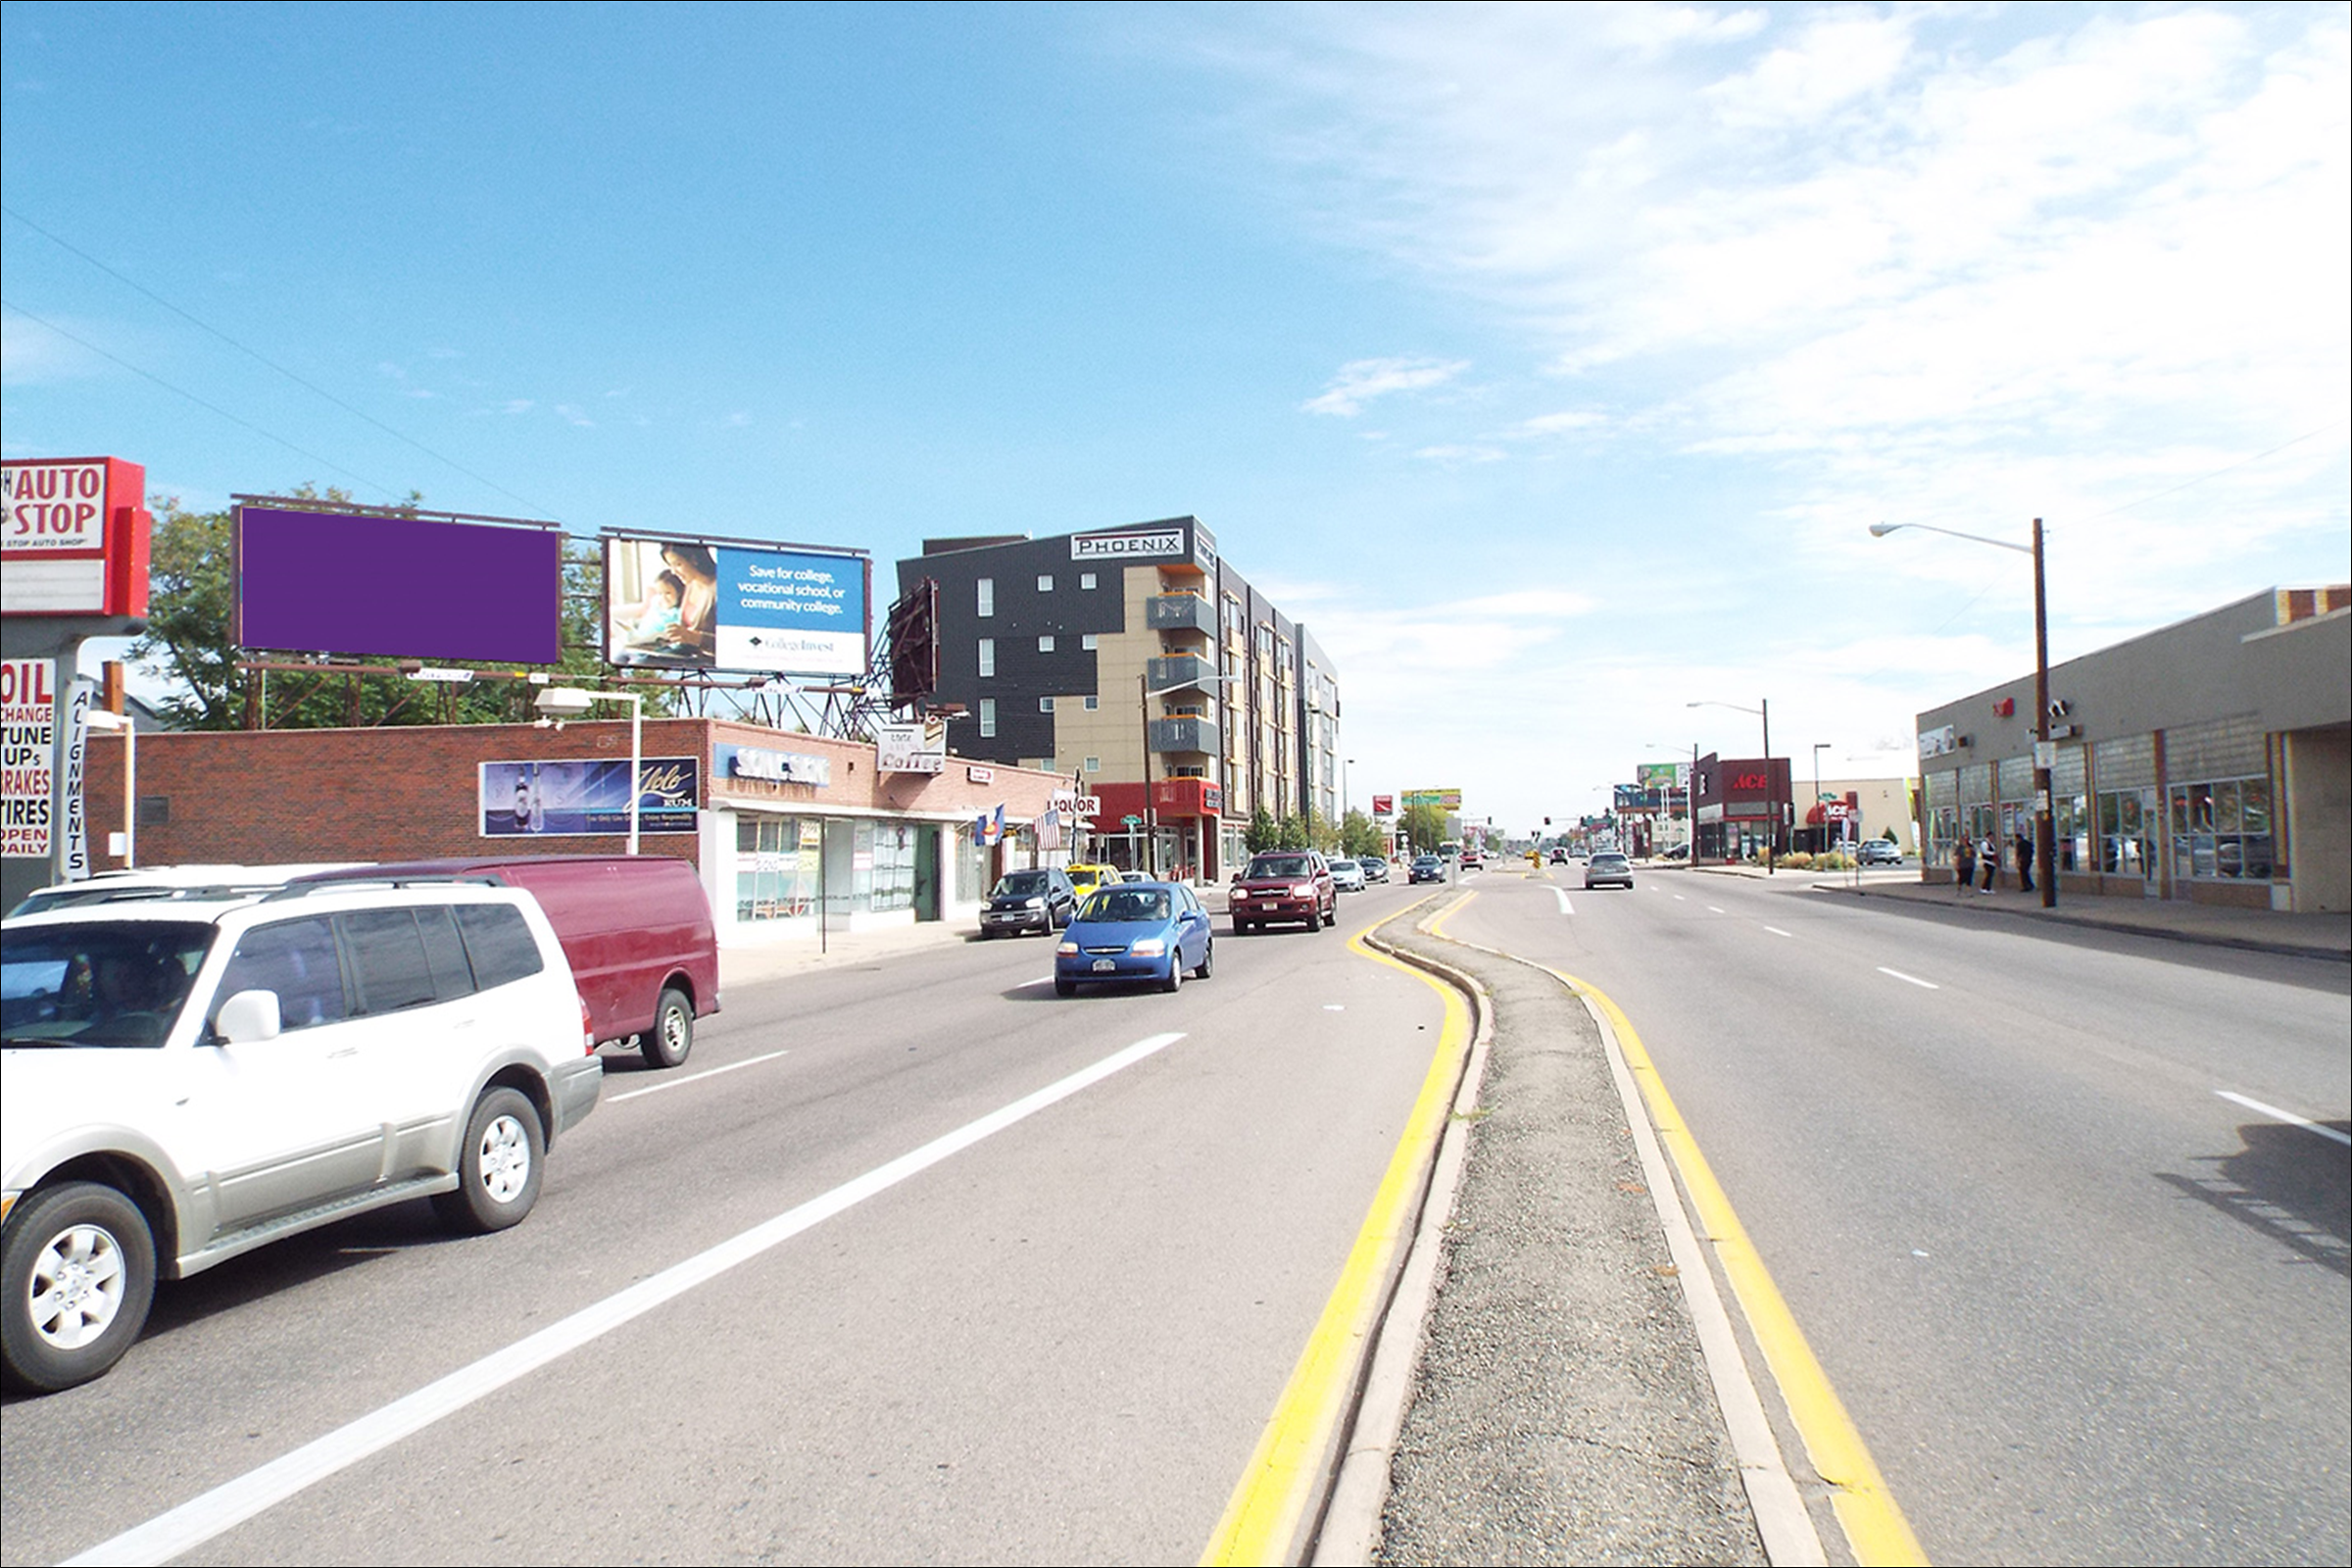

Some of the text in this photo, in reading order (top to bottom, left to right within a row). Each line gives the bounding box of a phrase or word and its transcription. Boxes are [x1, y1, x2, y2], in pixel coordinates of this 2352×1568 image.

[14, 467, 100, 500] AUTO
[14, 503, 96, 535] STOP
[32, 538, 56, 547] AUTO
[1079, 537, 1179, 555] PHOENIX
[749, 564, 835, 584] Save for college,
[737, 582, 846, 599] vocational school, or
[740, 598, 844, 616] community college.
[1, 663, 53, 704] OIL
[1, 726, 51, 745] TUNE
[67, 691, 86, 869] ALIGNMENTS
[1734, 773, 1767, 789] ACE
[663, 798, 693, 808] RUM
